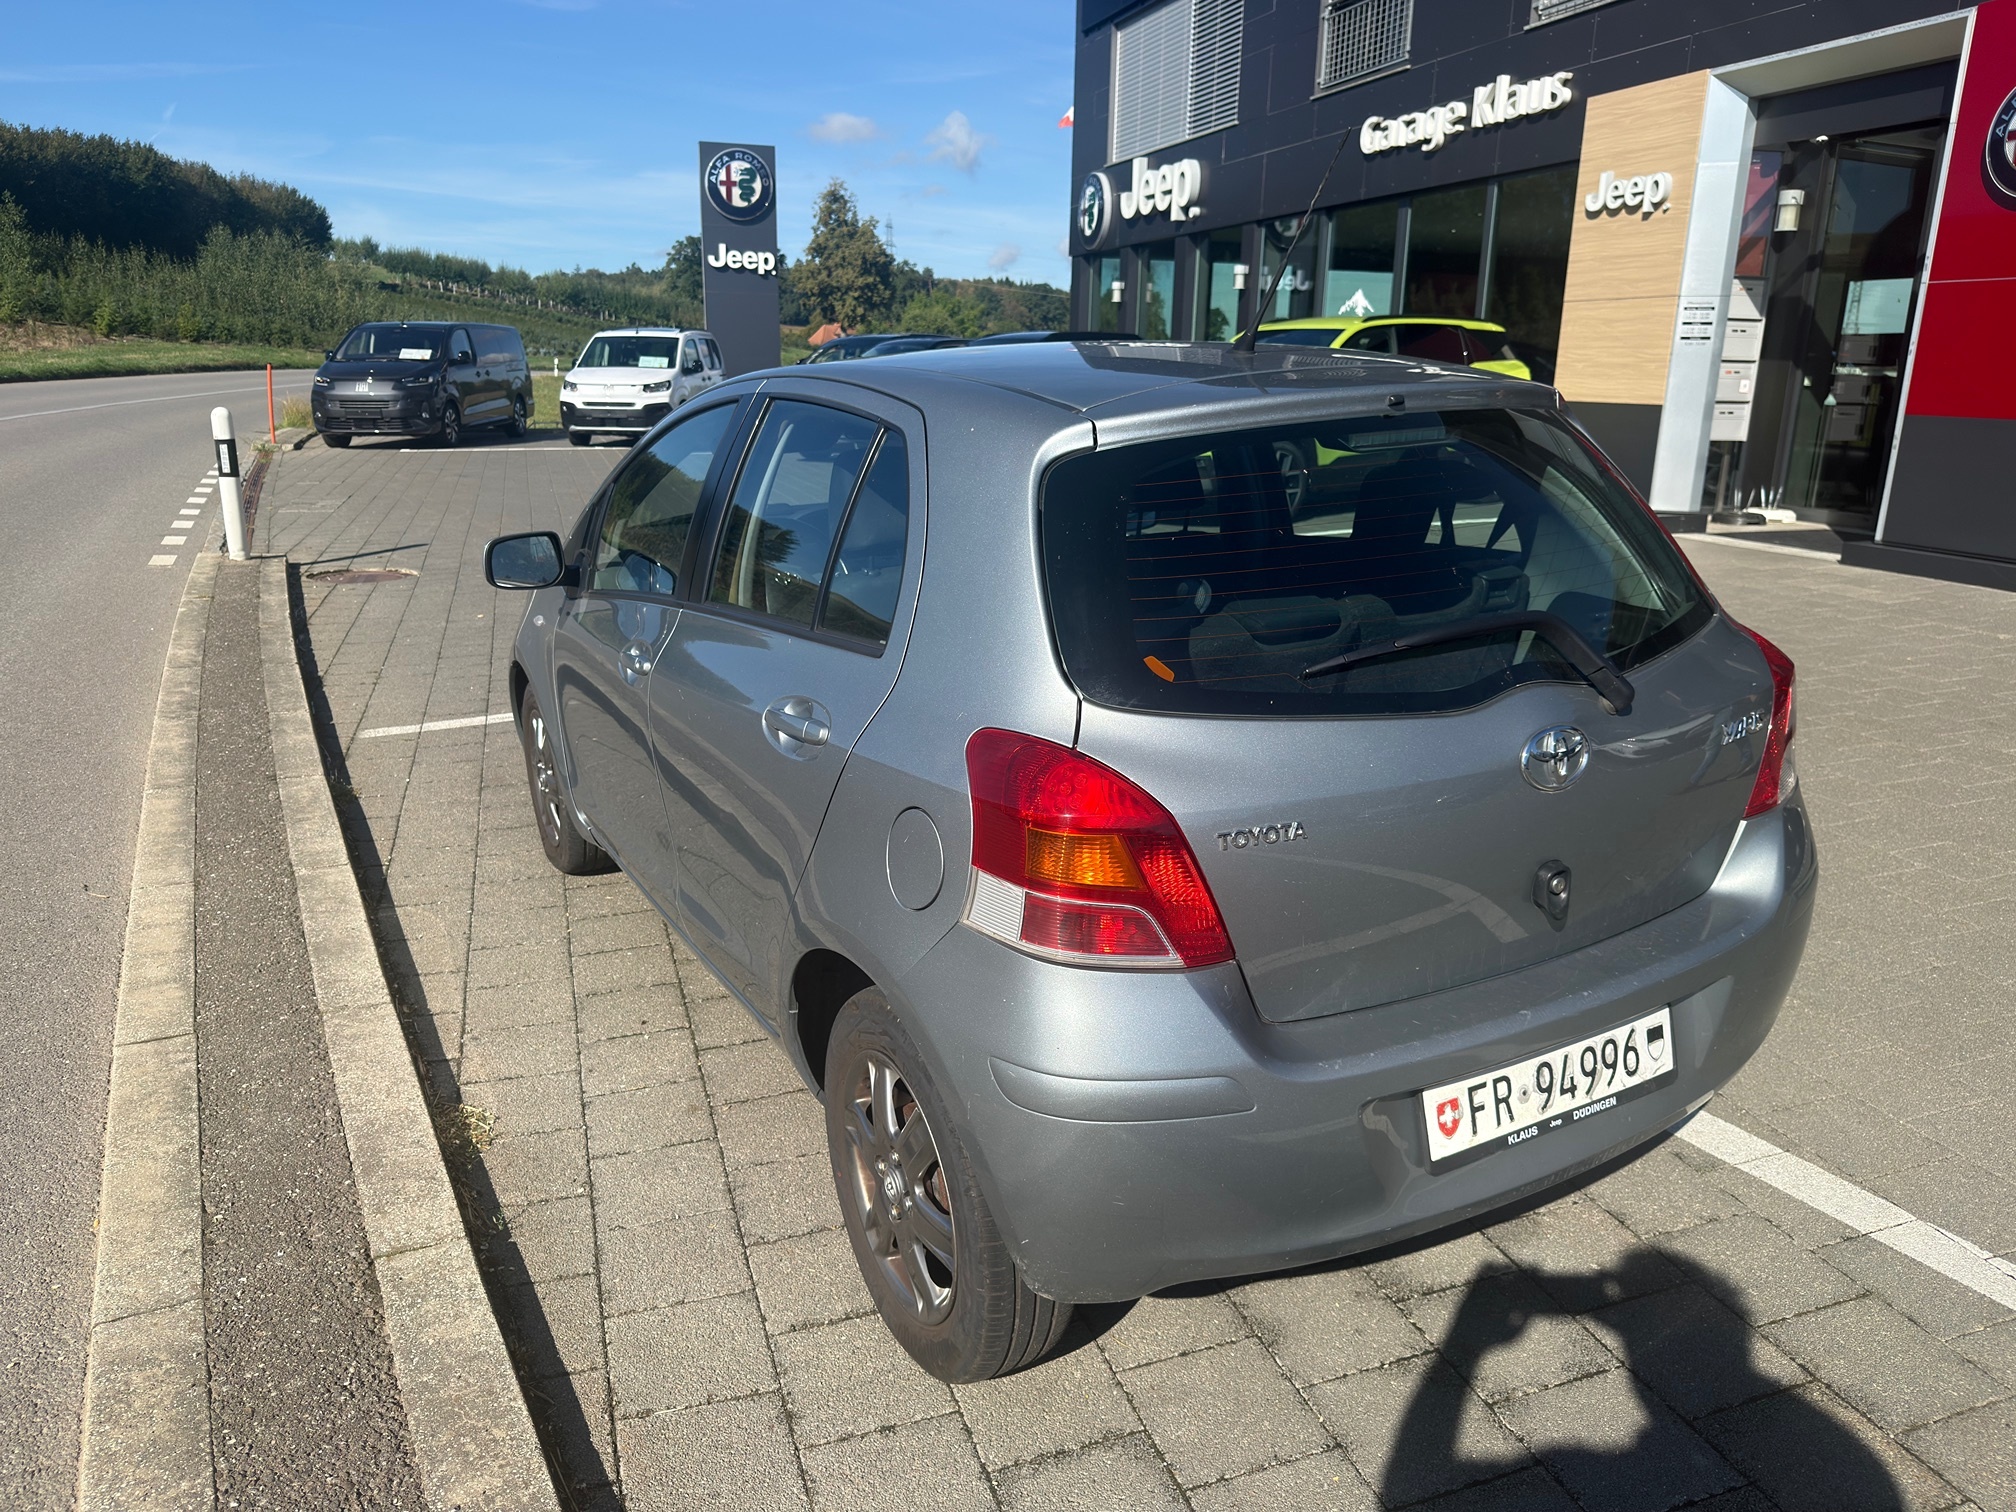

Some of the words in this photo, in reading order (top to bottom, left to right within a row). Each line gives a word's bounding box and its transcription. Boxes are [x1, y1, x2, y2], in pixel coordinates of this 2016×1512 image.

[1360, 101, 1467, 154] Garage
[1471, 71, 1574, 128] Klaus
[709, 155, 730, 183] ALFA
[735, 152, 769, 187] ROMEO
[1216, 821, 1308, 851] TOYOTA
[1508, 1126, 1538, 1145] KLAUS
[1549, 1119, 1562, 1128] Jeep
